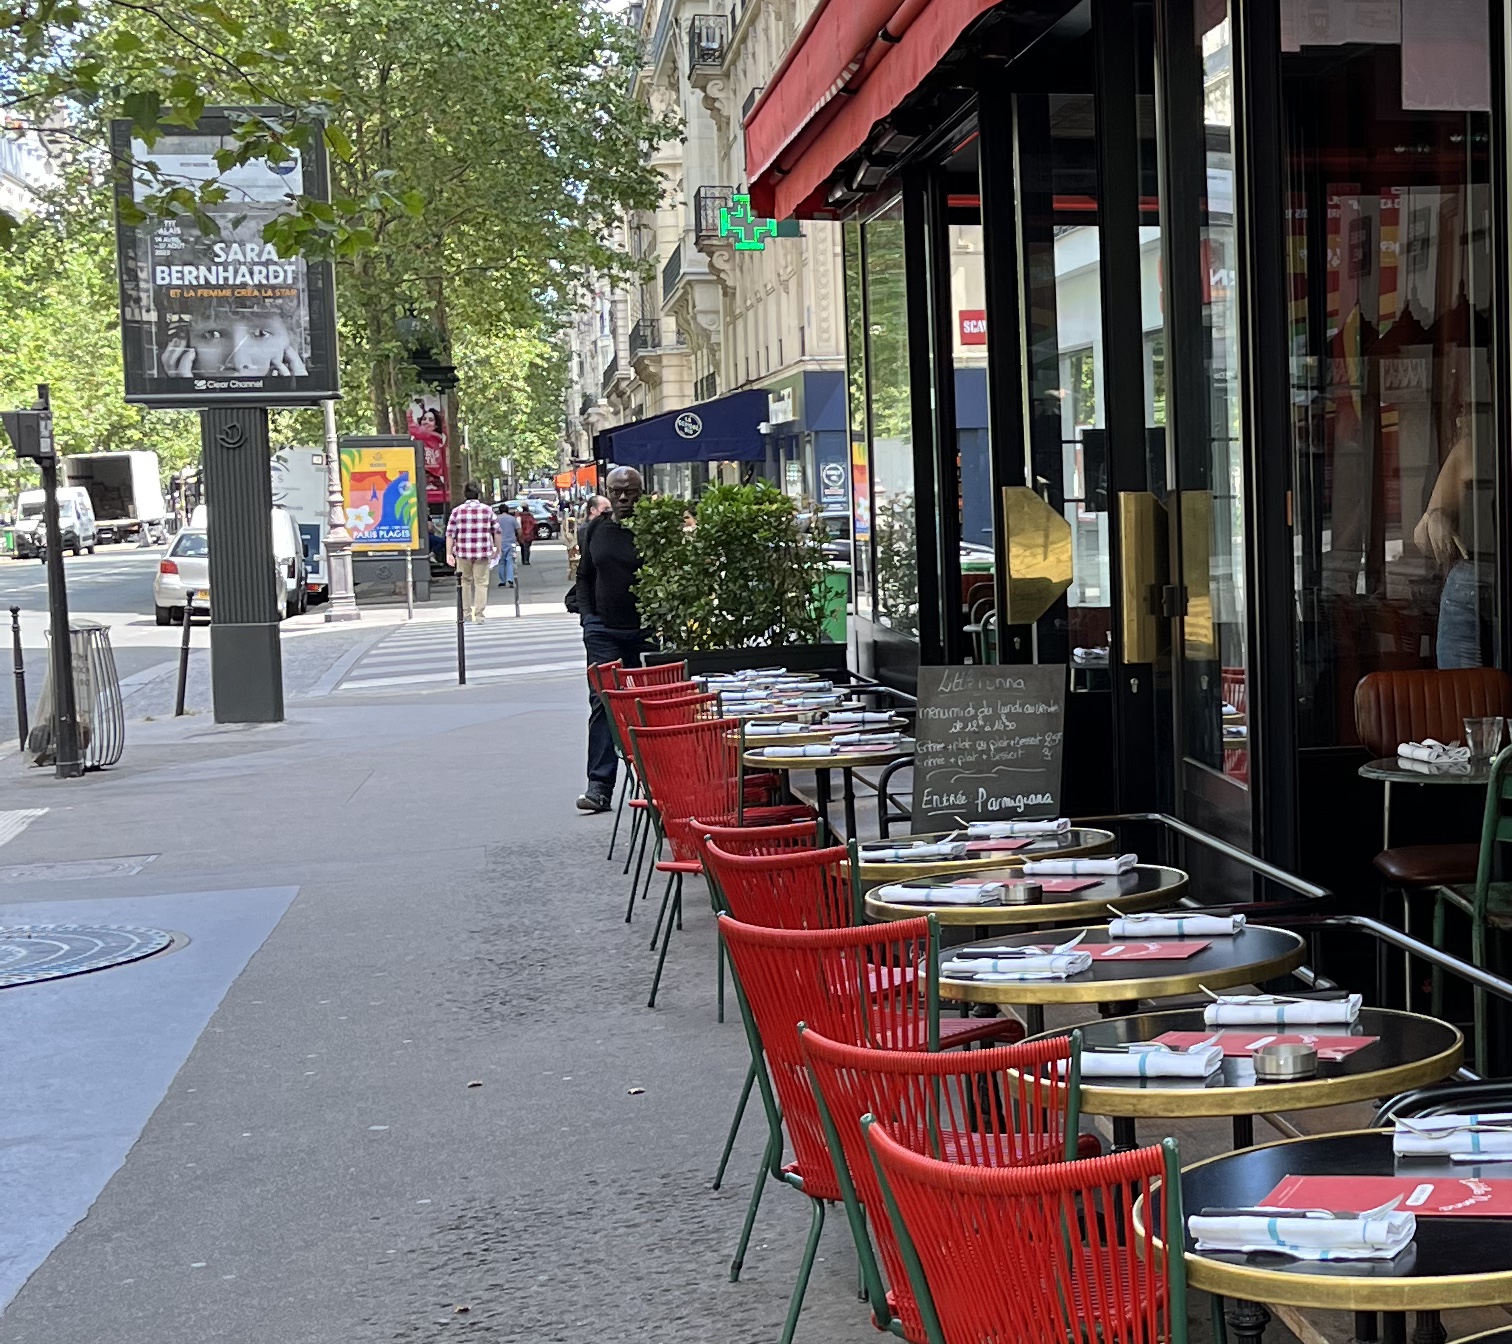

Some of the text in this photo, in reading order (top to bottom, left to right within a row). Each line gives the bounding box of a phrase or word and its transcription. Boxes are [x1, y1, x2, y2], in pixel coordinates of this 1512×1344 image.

[213, 242, 296, 263] SARA
[155, 264, 297, 286] BERNHARDT
[169, 288, 181, 298] ET
[183, 288, 195, 297] LA
[197, 288, 232, 298] FEMME
[206, 379, 264, 389] Clear Channel
[352, 530, 411, 539] PARIS PLAGES
[974, 787, 1054, 813] Parmigiana
